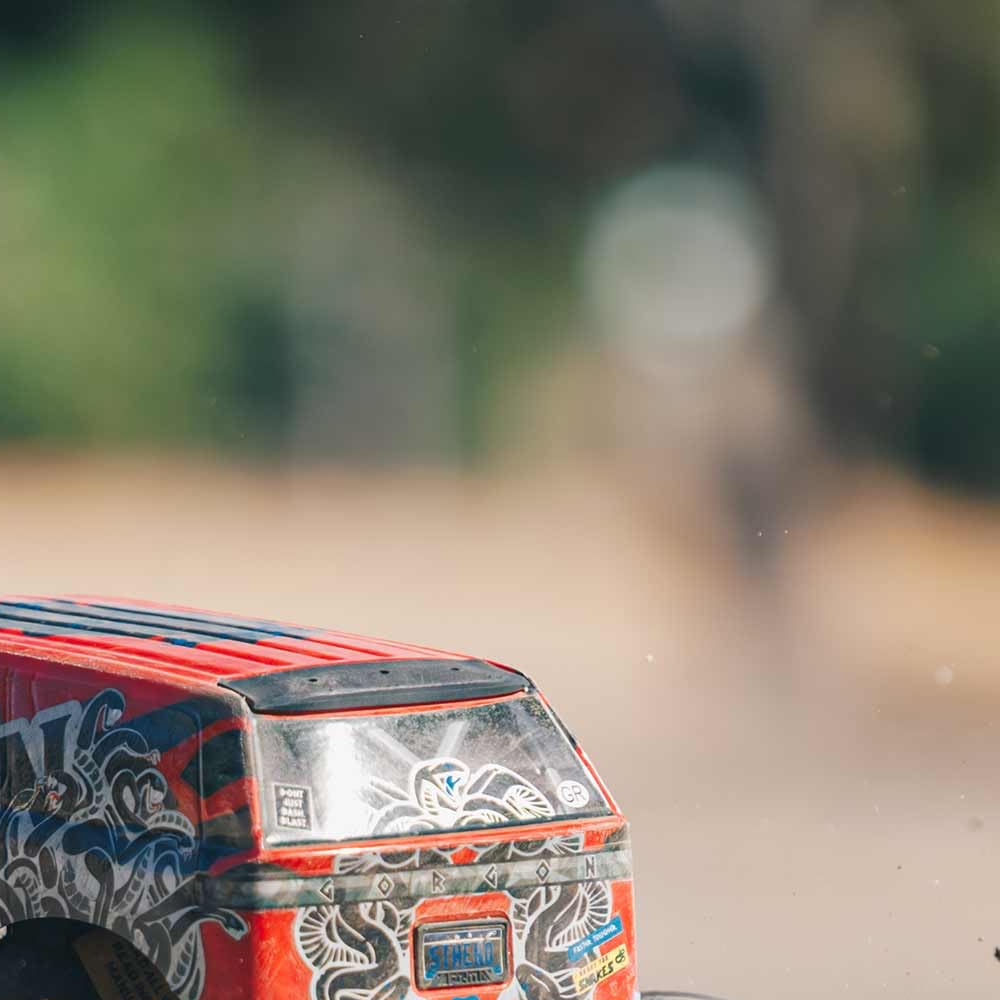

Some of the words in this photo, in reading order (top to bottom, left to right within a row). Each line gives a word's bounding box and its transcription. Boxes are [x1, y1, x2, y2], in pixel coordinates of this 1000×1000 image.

[560, 784, 587, 803] GR
[279, 816, 307, 828] BLAST
[319, 854, 598, 902] GORGON
